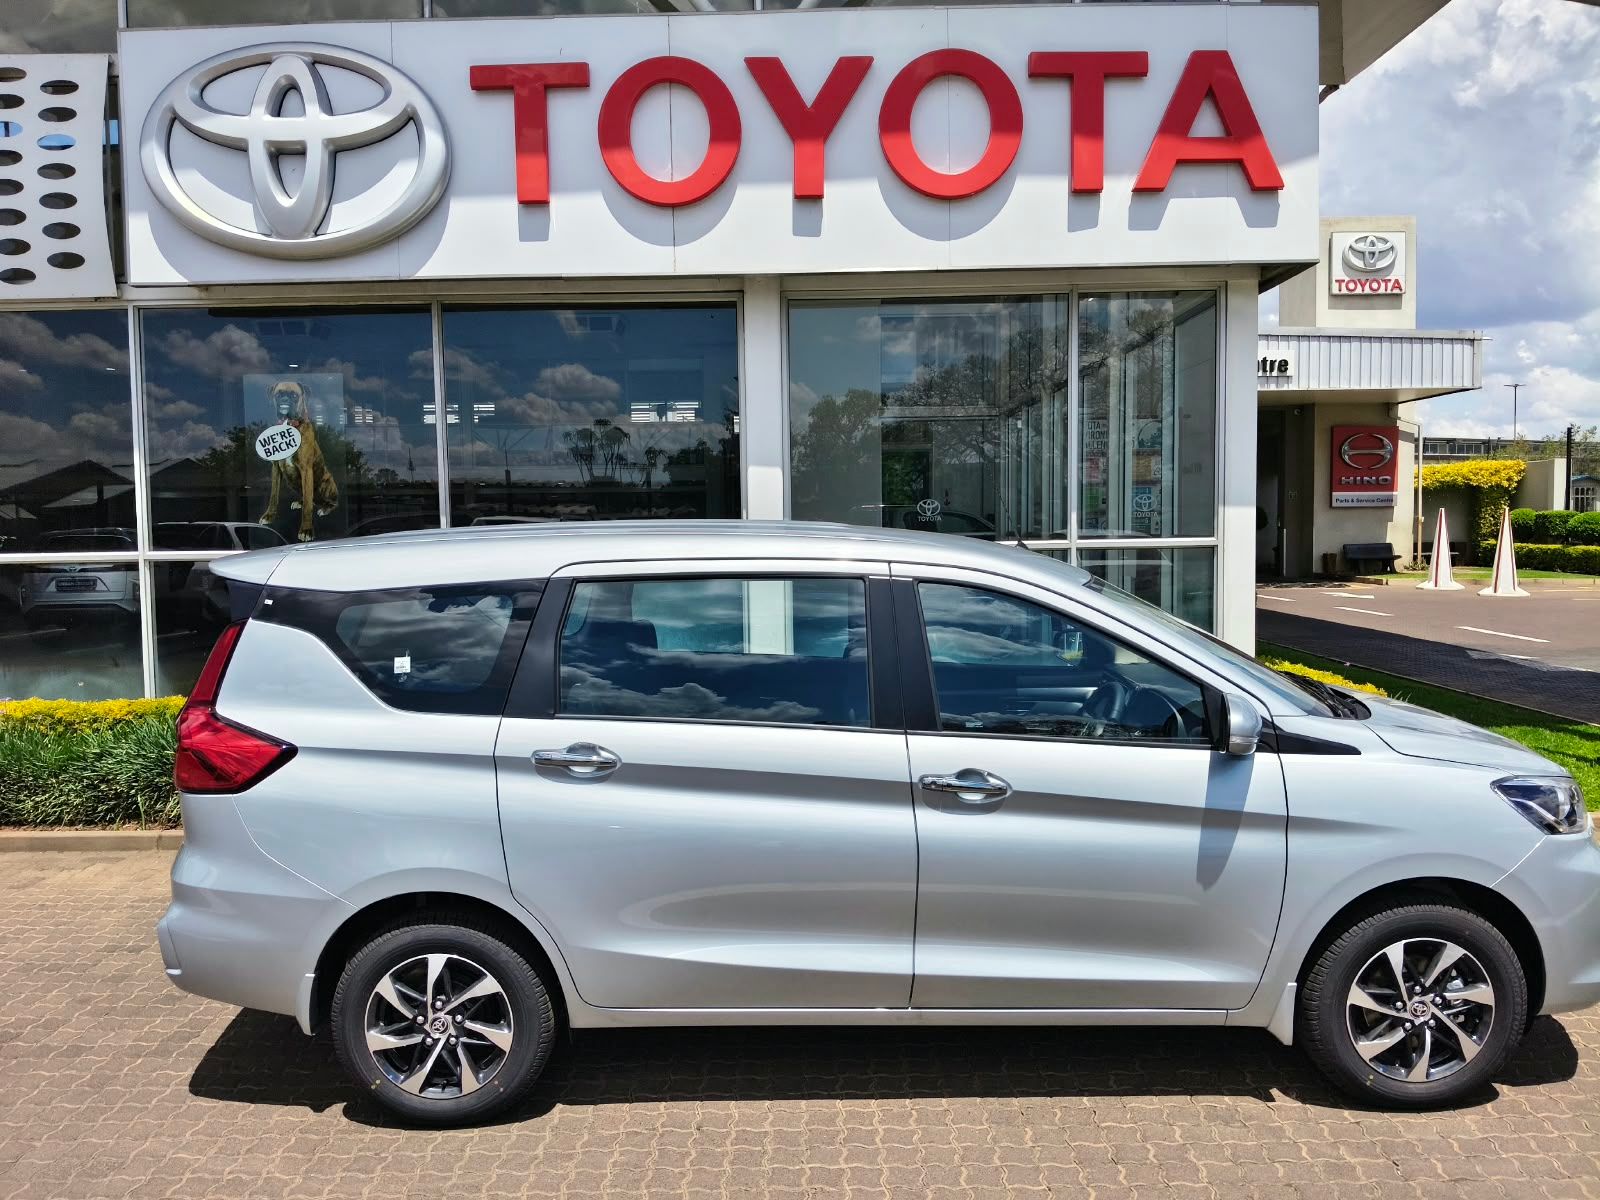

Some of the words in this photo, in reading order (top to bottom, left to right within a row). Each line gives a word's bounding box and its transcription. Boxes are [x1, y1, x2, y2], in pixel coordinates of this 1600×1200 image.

[470, 48, 1284, 207] TOYOTA
[1334, 278, 1403, 292] TOYOTA
[1257, 356, 1289, 372] tre
[258, 428, 295, 449] WE'RE
[263, 437, 298, 458] BACK!
[1341, 476, 1392, 485] HINO
